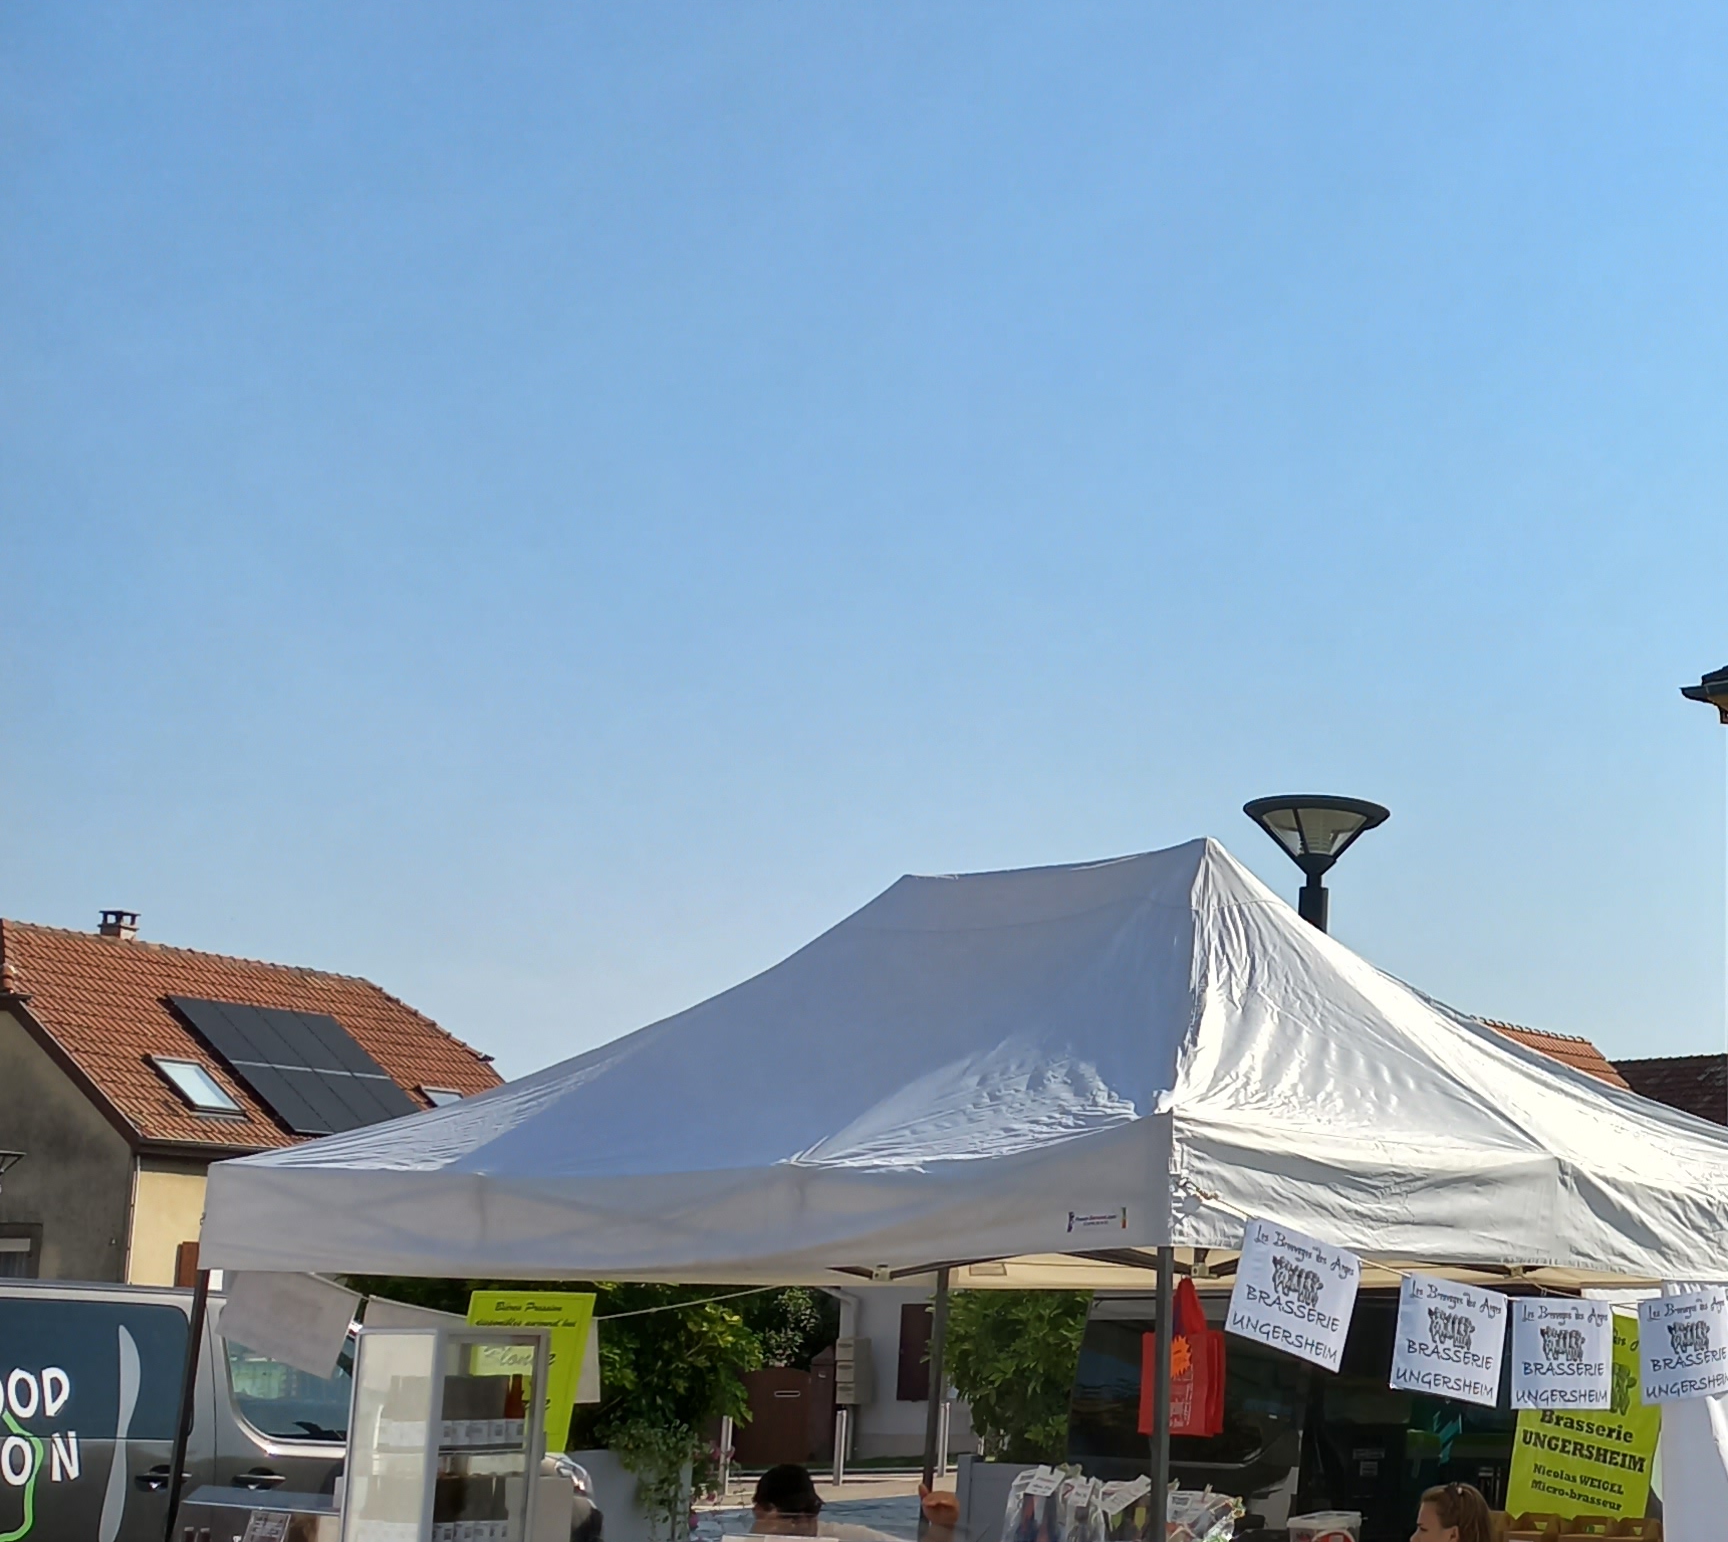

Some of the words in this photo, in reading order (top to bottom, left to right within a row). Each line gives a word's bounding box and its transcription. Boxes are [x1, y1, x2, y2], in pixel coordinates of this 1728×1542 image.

[1246, 1284, 1341, 1332] BRASSERIE
[1232, 1311, 1338, 1363] UNGERSHEIM
[1406, 1338, 1494, 1370] BRASSERIE
[1522, 1361, 1605, 1376] BRASSERIE
[1650, 1346, 1727, 1372] BRASSERIE
[0, 1367, 70, 1419] OD
[1396, 1367, 1493, 1399] UNGERSHEIM
[1516, 1389, 1608, 1406] UNGERSHEIM
[1539, 1410, 1634, 1443] Brasserie
[1522, 1429, 1646, 1473] UNGERSHEIM
[1531, 1479, 1622, 1512] Micro-brasseur
[1533, 1463, 1578, 1484] Nicolas
[1579, 1474, 1625, 1496] WEIGEL
